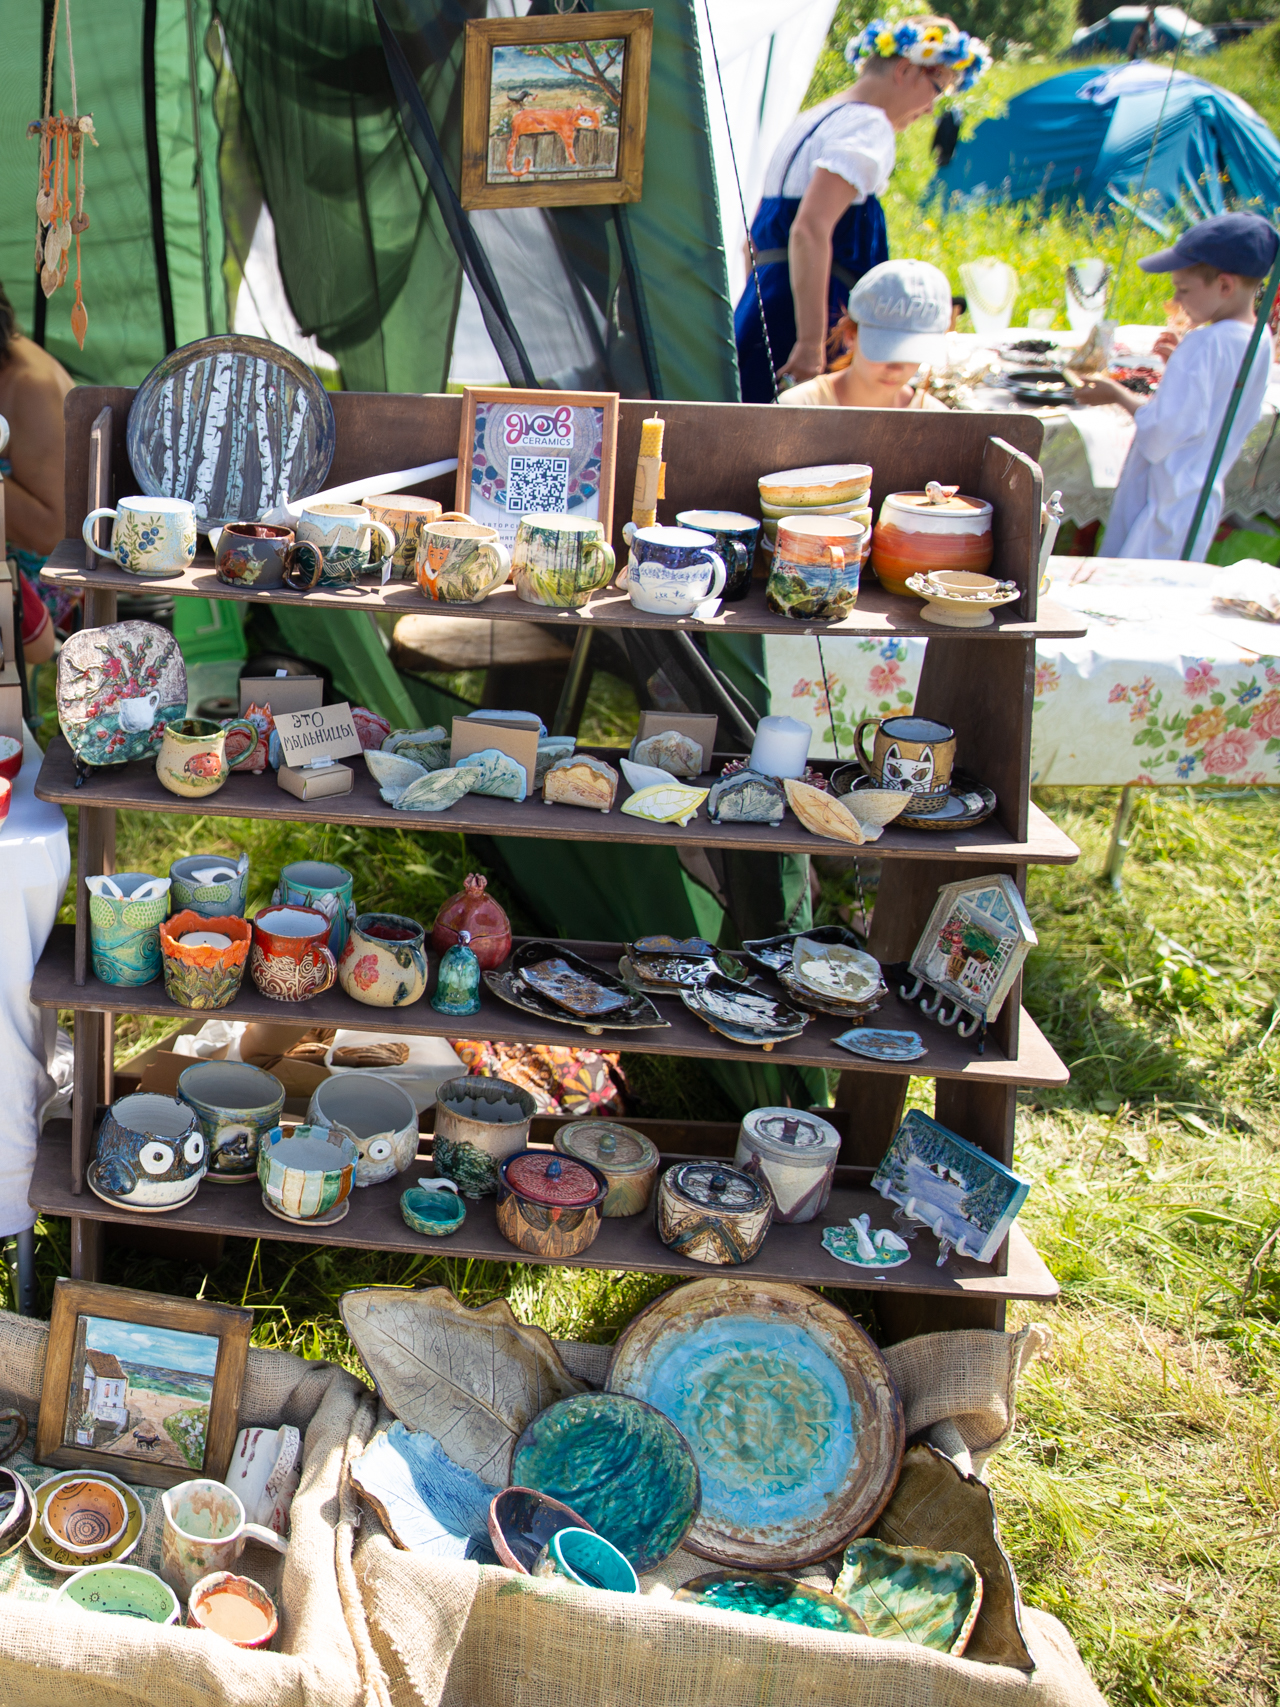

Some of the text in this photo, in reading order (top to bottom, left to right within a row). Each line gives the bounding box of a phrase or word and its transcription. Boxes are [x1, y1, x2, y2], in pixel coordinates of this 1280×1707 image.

[522, 437, 571, 446] CERAMICS
[292, 711, 324, 728] ЭТО
[283, 724, 355, 751] МЫЛЬНИЦЫ
